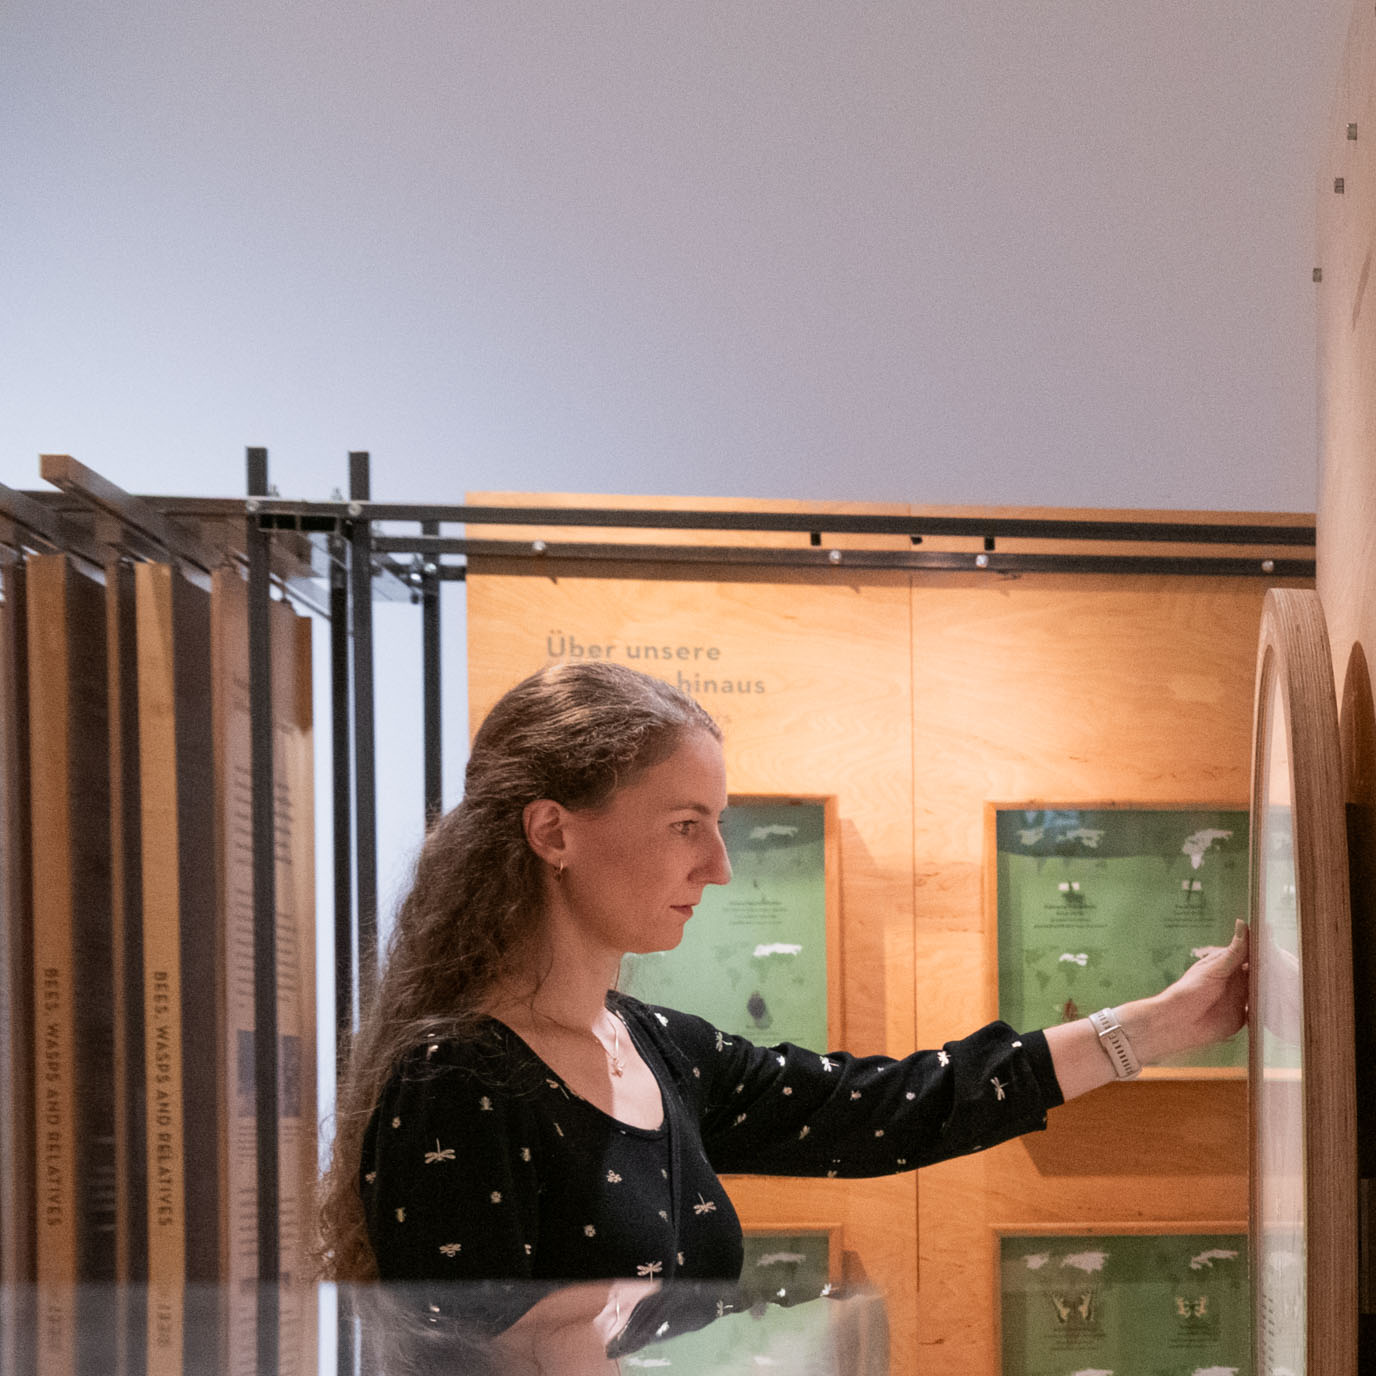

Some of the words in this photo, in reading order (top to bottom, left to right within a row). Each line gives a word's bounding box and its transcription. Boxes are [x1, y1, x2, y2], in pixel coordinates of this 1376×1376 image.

[547, 629, 616, 659] Über
[626, 643, 721, 660] unsere
[678, 671, 766, 695] hinaus
[154, 1025, 170, 1083] WASPS
[46, 1088, 60, 1126] AND
[156, 1089, 170, 1126] AND
[47, 1131, 61, 1227] RELATIVES
[157, 1133, 173, 1227] RELATIVES
